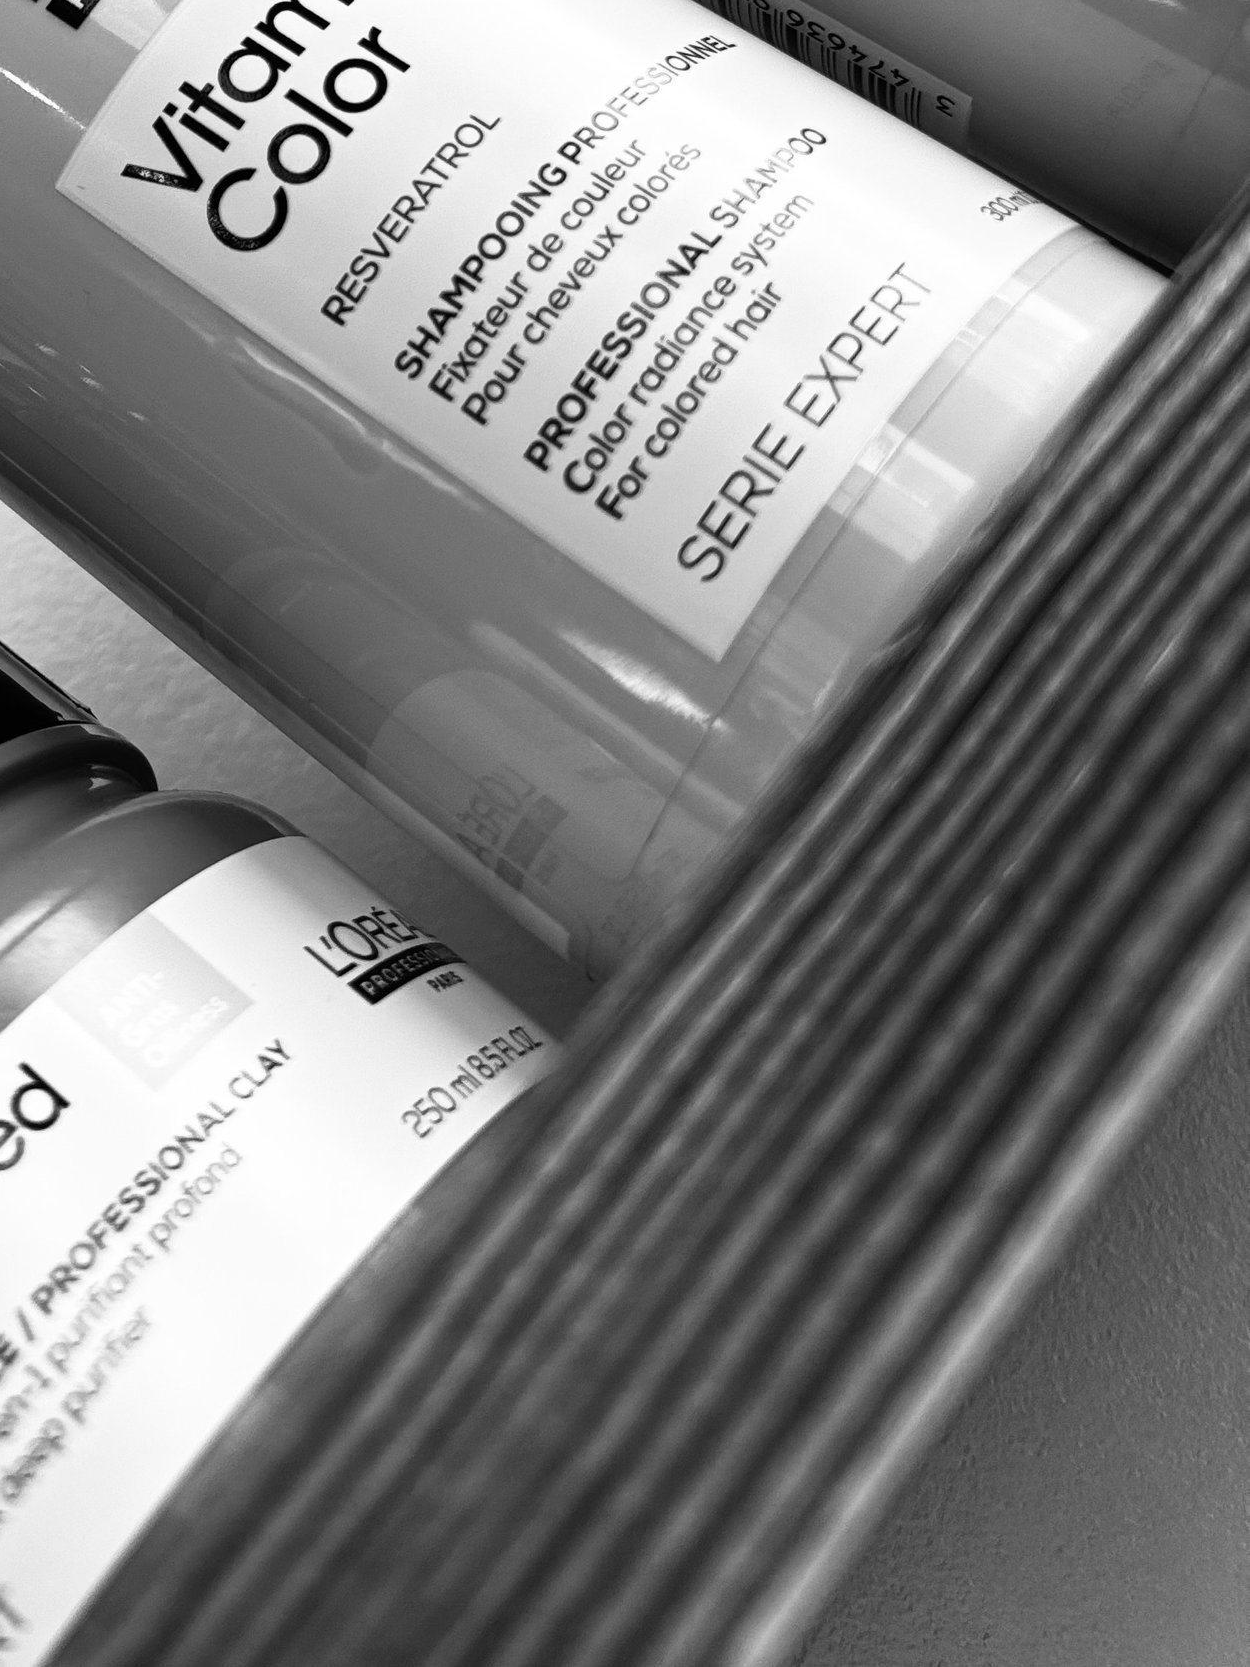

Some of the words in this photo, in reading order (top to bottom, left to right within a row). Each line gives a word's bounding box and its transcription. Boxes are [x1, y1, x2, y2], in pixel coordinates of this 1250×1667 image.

[206, 26, 412, 253] Color
[320, 113, 502, 327] RESVERATROL
[394, 161, 568, 380] SHAMPOOING
[558, 33, 738, 168] PROFESSIONNEL
[428, 269, 530, 403] Fixateur
[526, 232, 565, 275] de
[560, 137, 649, 232] couleur
[459, 343, 526, 427] Pour
[523, 226, 625, 348] cheveux
[616, 141, 703, 228] colorés
[523, 230, 723, 474] PROFESSIONAL
[709, 126, 828, 230] SHAMPOO
[562, 402, 641, 497] Color
[628, 273, 738, 408] radiance
[730, 191, 816, 278] system
[595, 454, 651, 522] For
[645, 337, 740, 460] colored
[722, 278, 786, 345] hair
[677, 422, 806, 583] SERIE
[783, 261, 932, 429] EXPERT
[30, 1100, 237, 1316] PROFESSIONAL
[228, 1038, 291, 1101] CLAY
[148, 1143, 243, 1253] profond
[402, 1086, 457, 1138] 250
[449, 1064, 484, 1099] ml
